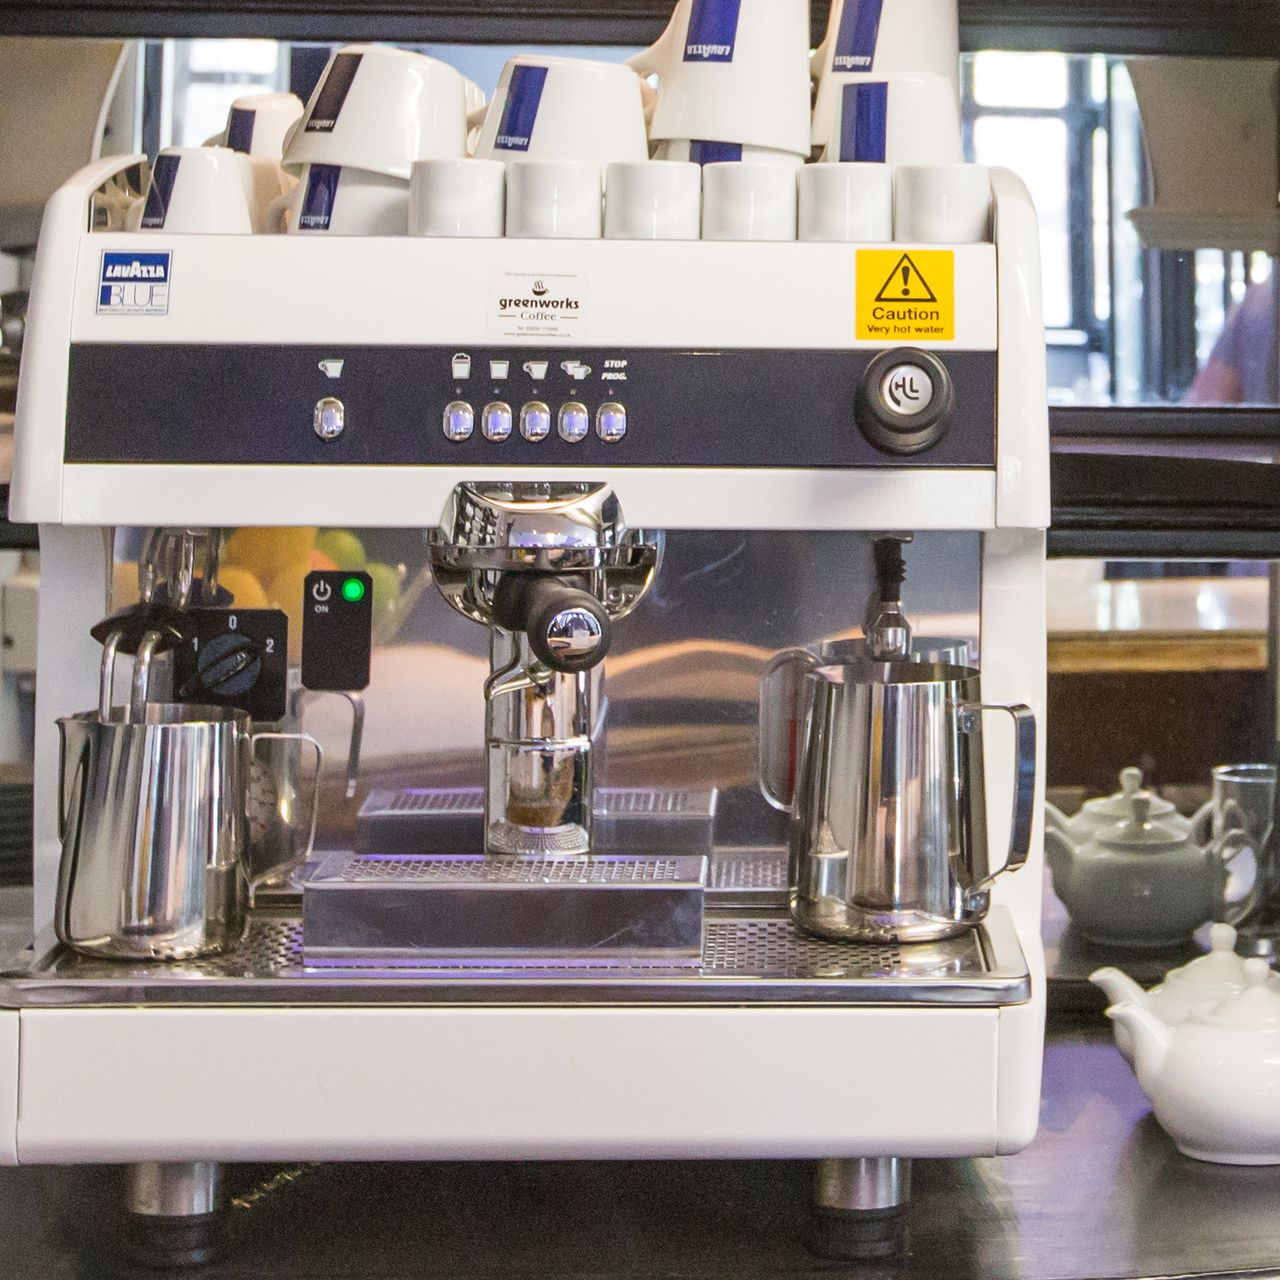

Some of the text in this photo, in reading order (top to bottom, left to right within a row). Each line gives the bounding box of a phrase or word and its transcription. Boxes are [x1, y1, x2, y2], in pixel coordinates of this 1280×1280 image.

[687, 45, 732, 58] LAVAZZA
[834, 56, 872, 68] LAVAZZA
[106, 261, 165, 278] LAVAZZA
[100, 285, 167, 307] BLUE
[499, 298, 579, 310] greenworks
[520, 311, 557, 321] Coffee
[872, 307, 939, 320] Caution
[867, 325, 944, 334] Very hot water
[604, 360, 627, 369] STOP
[601, 372, 627, 380] PROG.
[315, 605, 329, 613] ON
[192, 637, 198, 651] 1
[266, 638, 274, 653] 2
